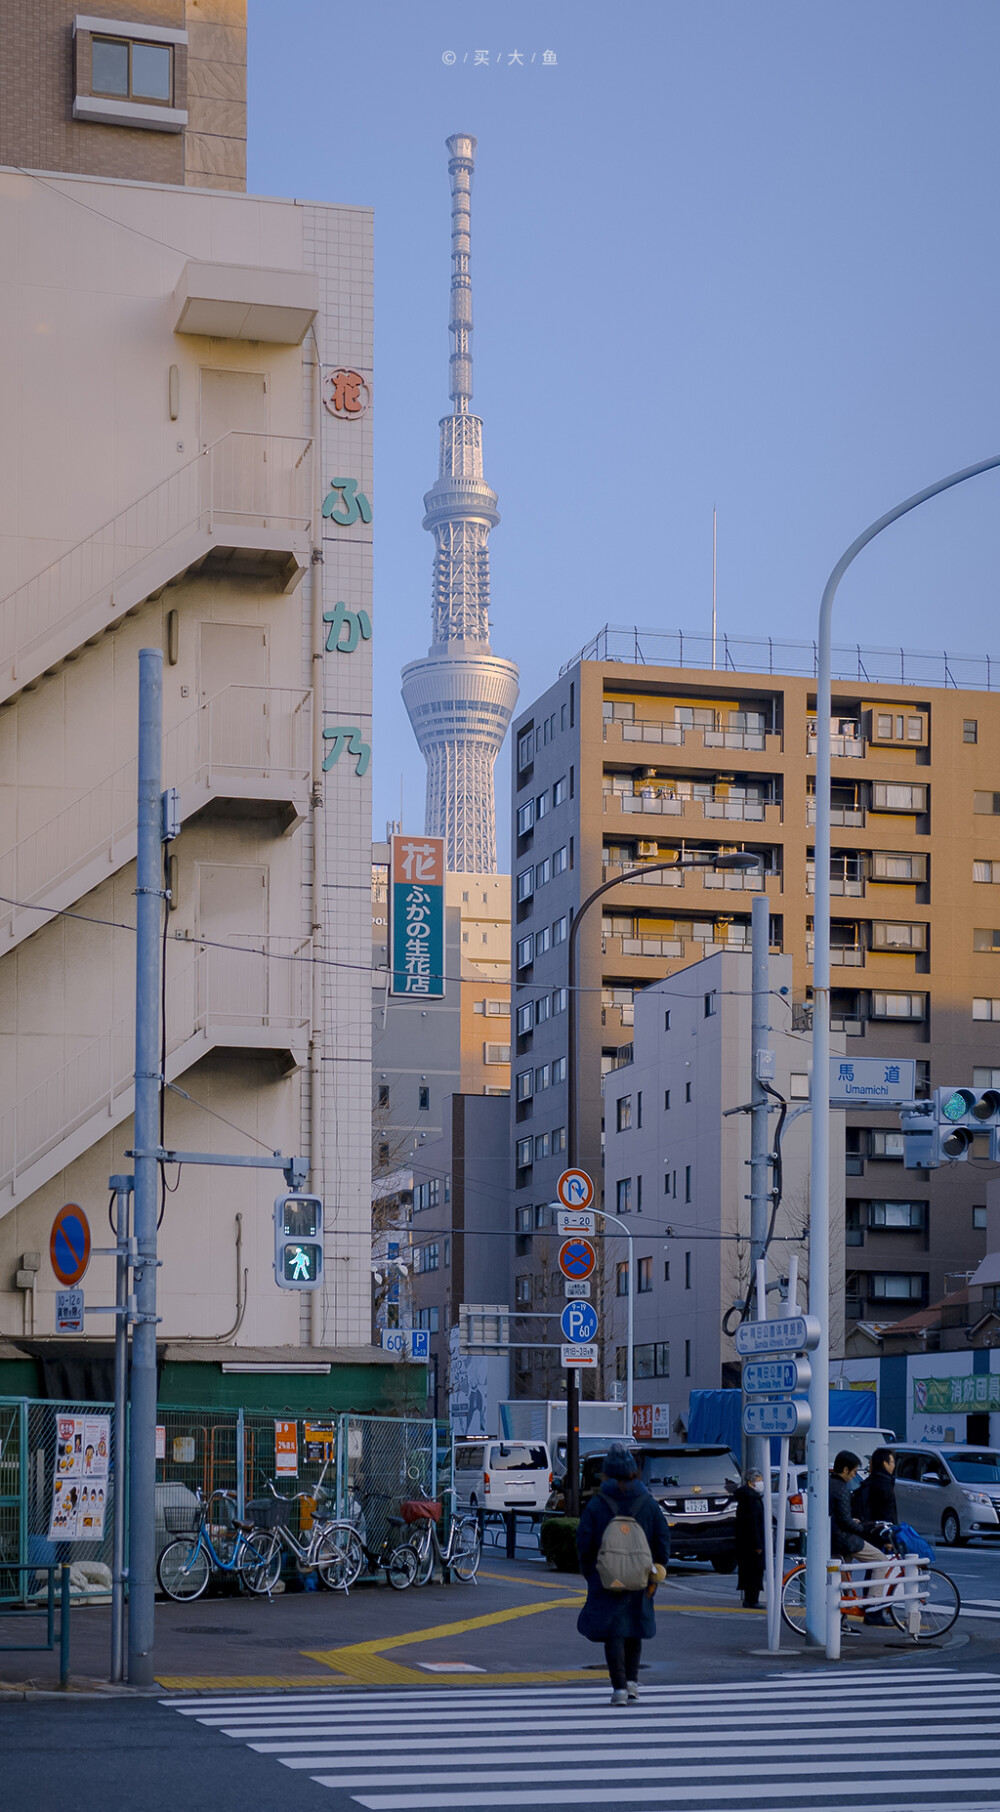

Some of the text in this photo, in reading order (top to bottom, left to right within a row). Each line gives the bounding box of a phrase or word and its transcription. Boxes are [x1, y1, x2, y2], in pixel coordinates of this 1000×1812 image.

[401, 843, 436, 880] 花
[405, 885, 431, 993] ふかの生花店
[838, 1064, 900, 1084] 馬道
[845, 1084, 889, 1096] Umamichi
[569, 1310, 584, 1338] P
[416, 1333, 425, 1348] P
